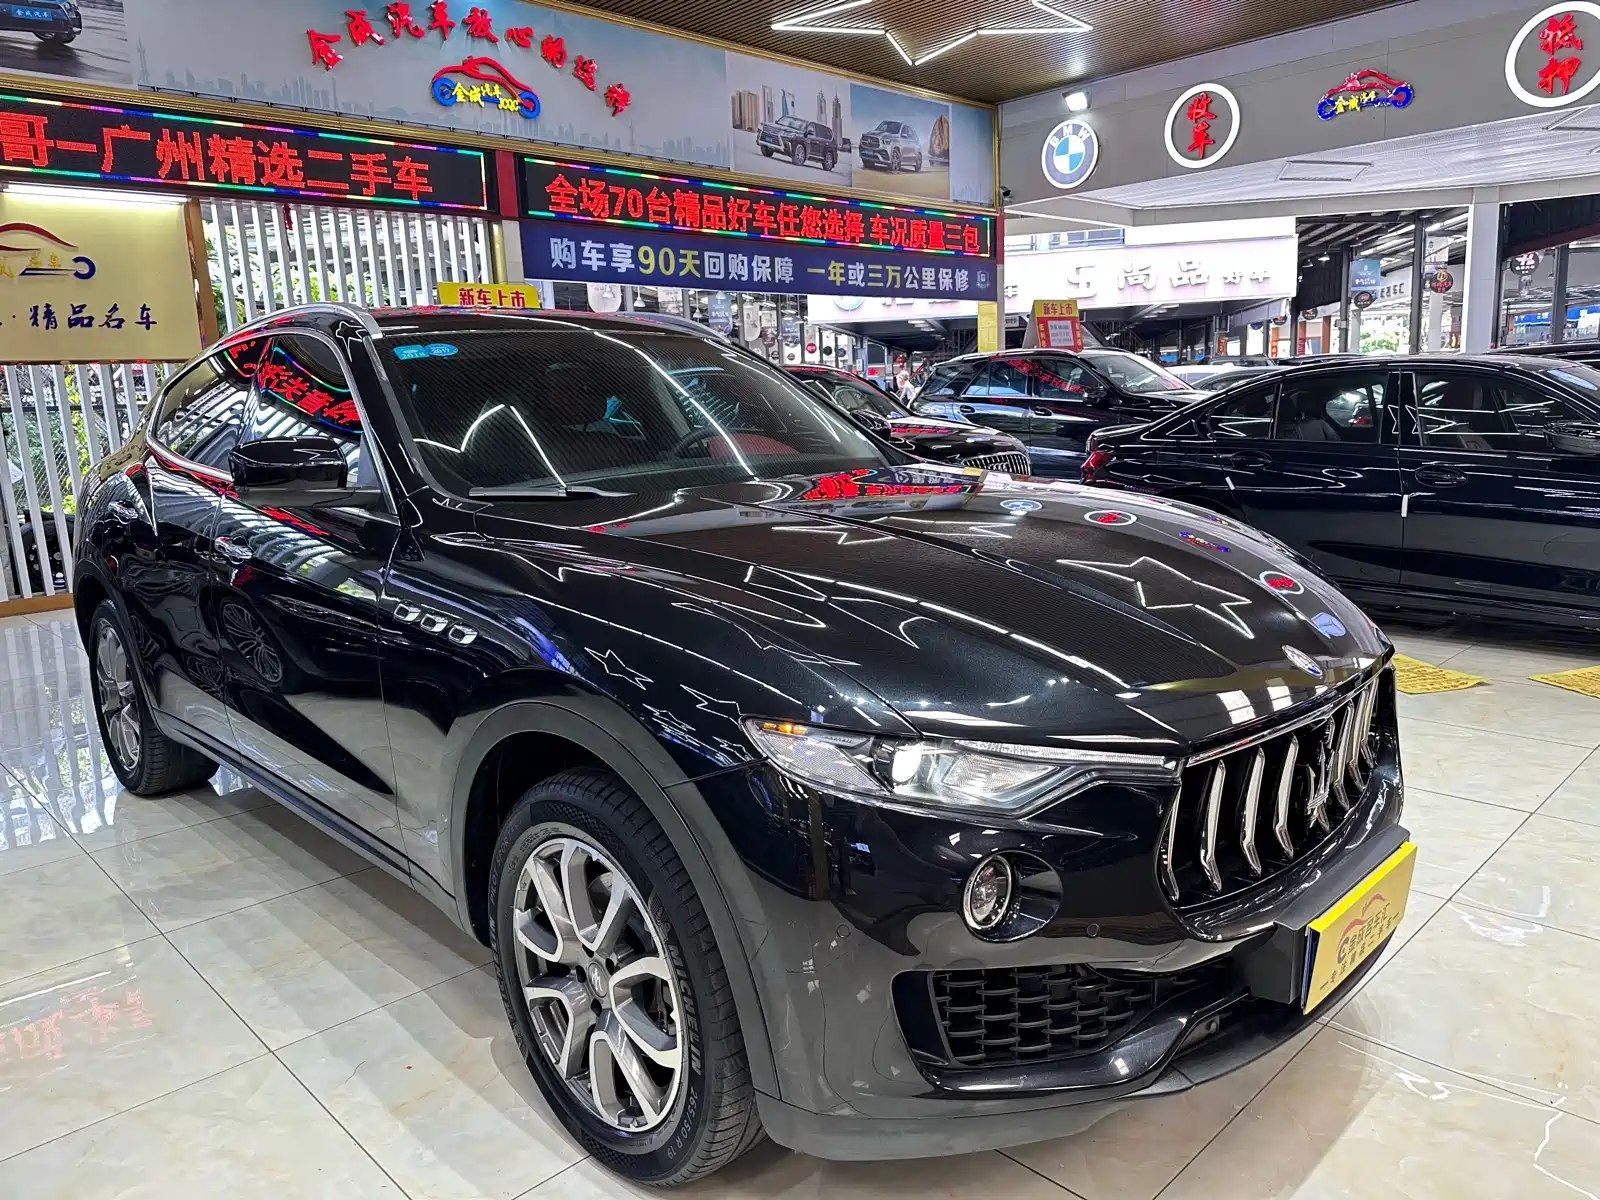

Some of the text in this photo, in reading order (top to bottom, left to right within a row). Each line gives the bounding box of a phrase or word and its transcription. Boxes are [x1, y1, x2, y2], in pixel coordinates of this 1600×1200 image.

[1049, 124, 1091, 148] BMW
[870, 213, 980, 252] 车况质量三包
[550, 237, 970, 291] 购车享90天回购保障 一年或三万公里保修
[29, 303, 158, 330] 精品名车
[669, 944, 702, 1076] MICHELIN
[681, 1086, 698, 1139] 265/50
